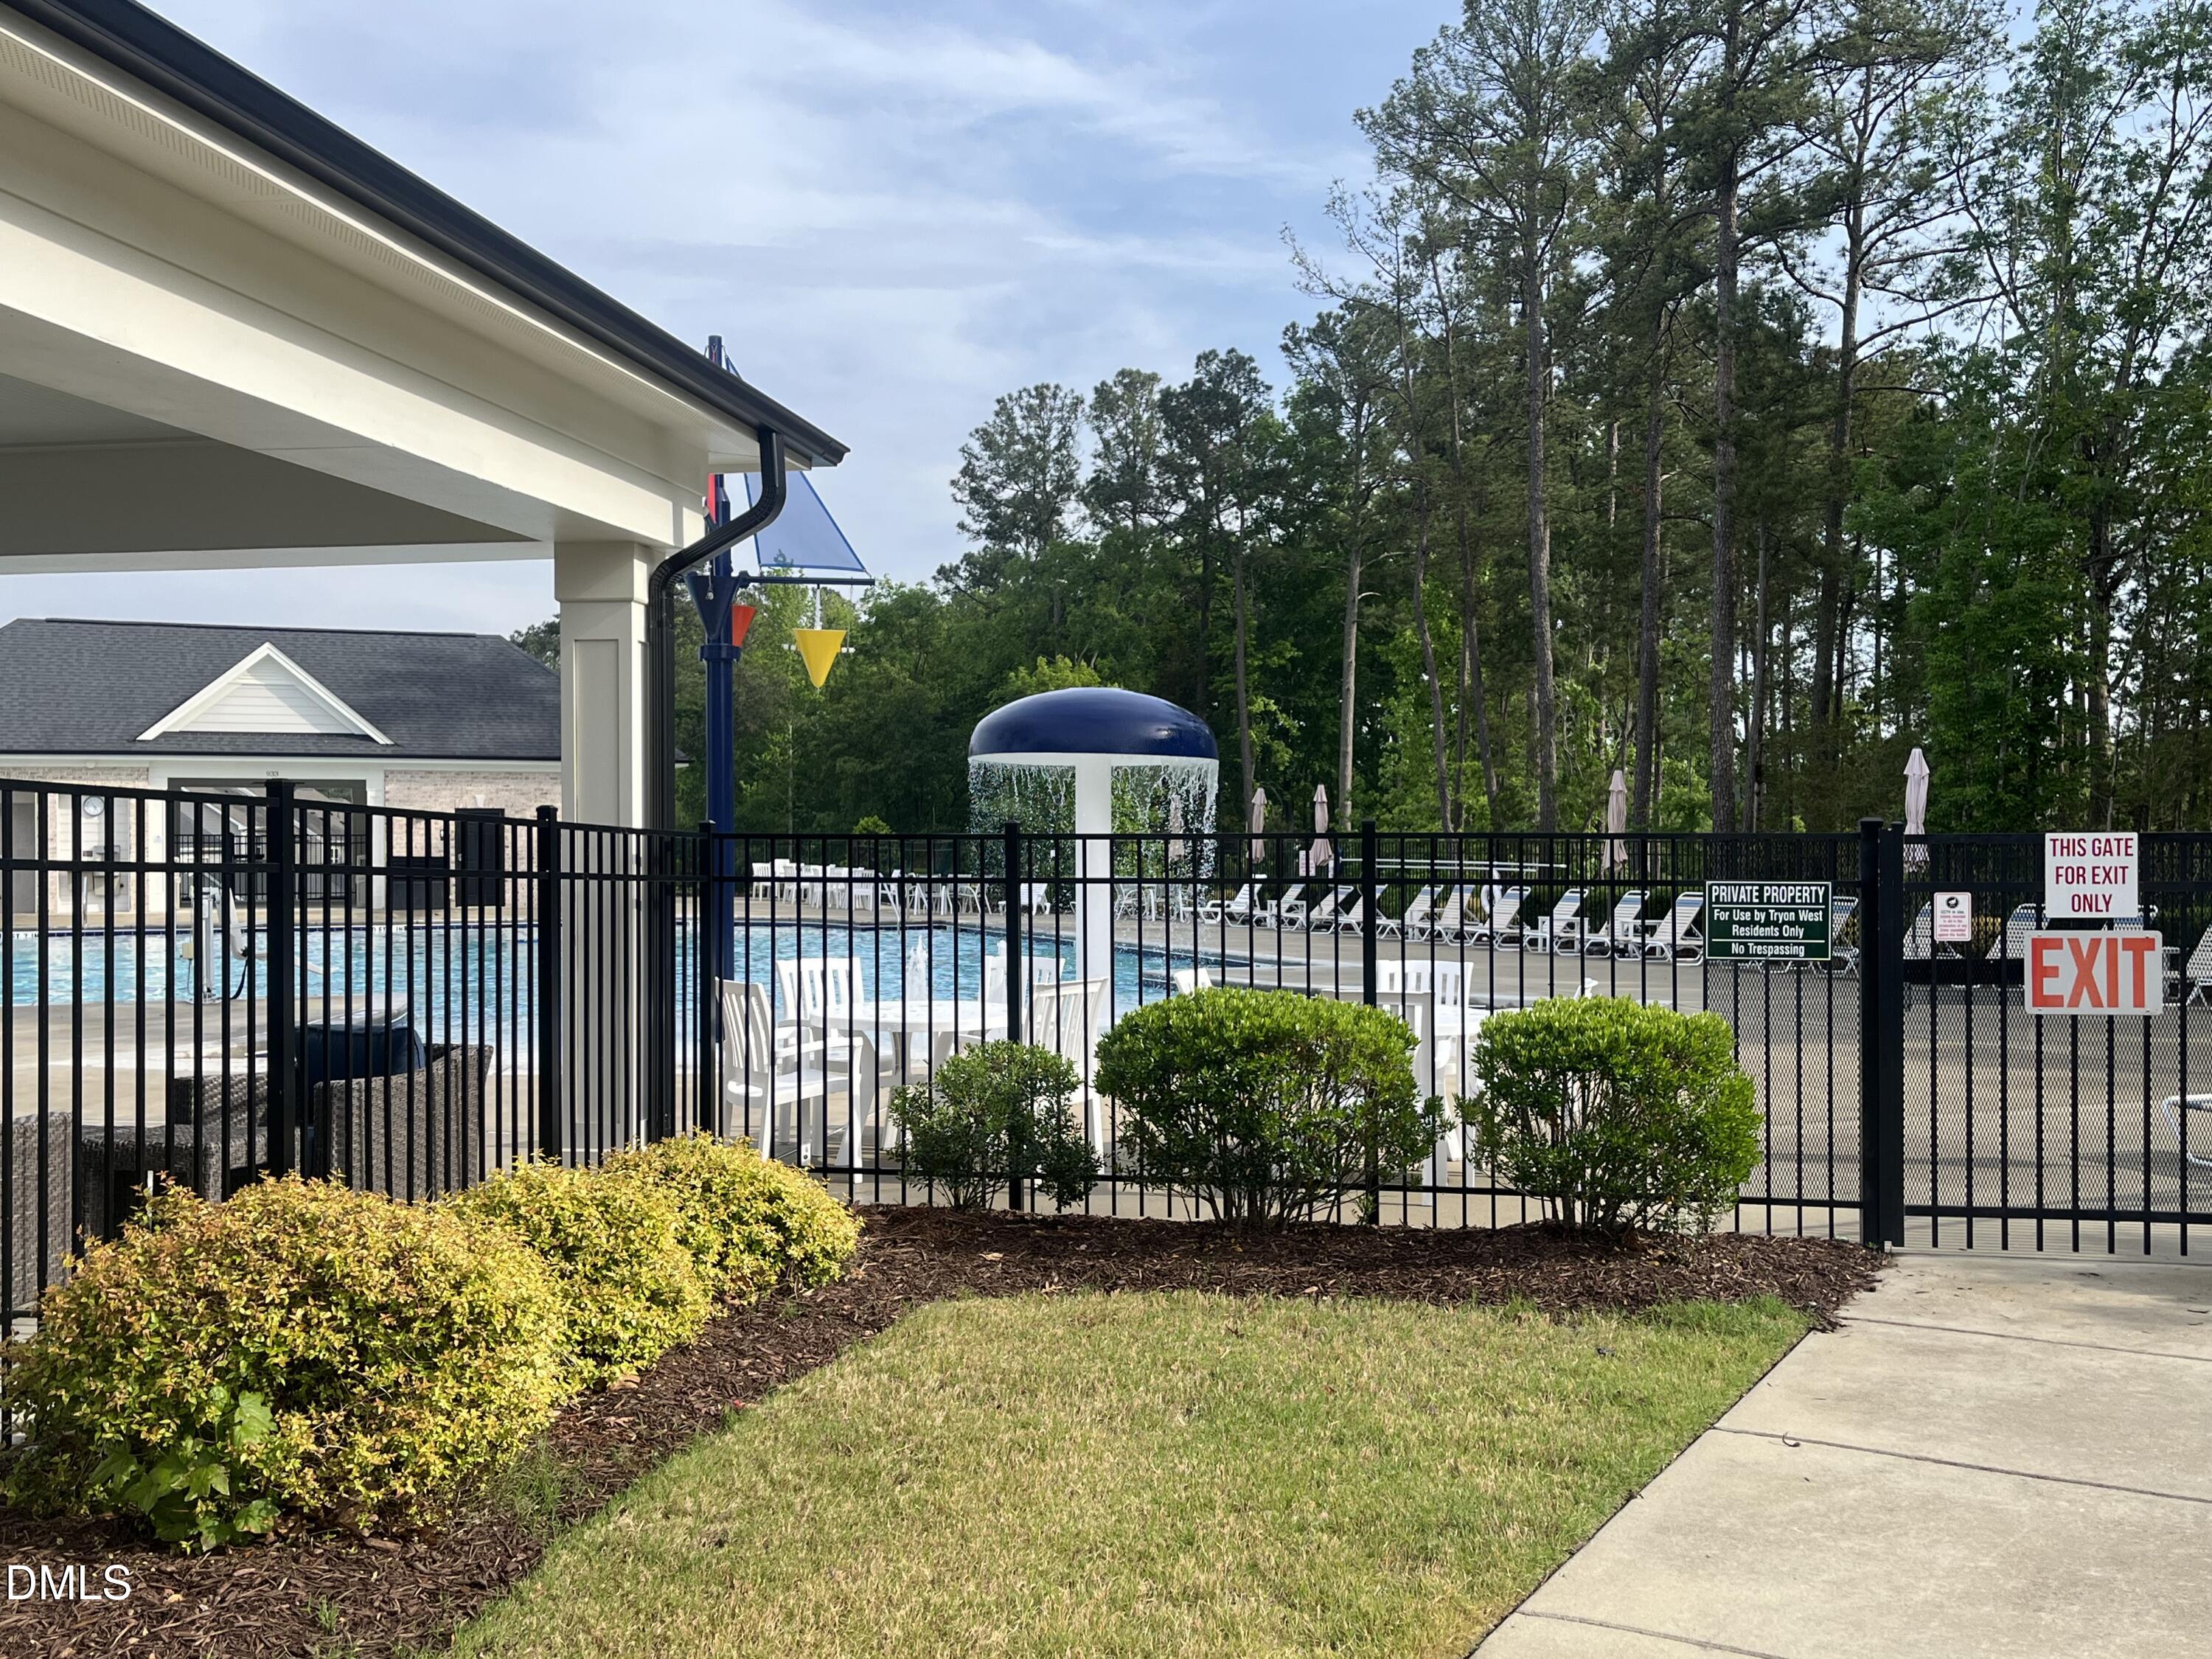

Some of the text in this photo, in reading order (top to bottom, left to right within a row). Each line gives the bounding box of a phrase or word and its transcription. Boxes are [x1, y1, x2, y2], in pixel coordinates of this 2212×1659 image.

[2049, 838, 2134, 857] THIS GATE
[2055, 866, 2129, 885] FOR EXIT
[1711, 885, 1825, 903] PRIVATE PROPERTY
[2070, 894, 2112, 913] ONLY
[1714, 908, 1823, 923] For Use by Tryon West
[1732, 924, 1804, 939] Residents Only
[1731, 942, 1805, 957] No Trespassing
[2031, 937, 2156, 1008] EXIT
